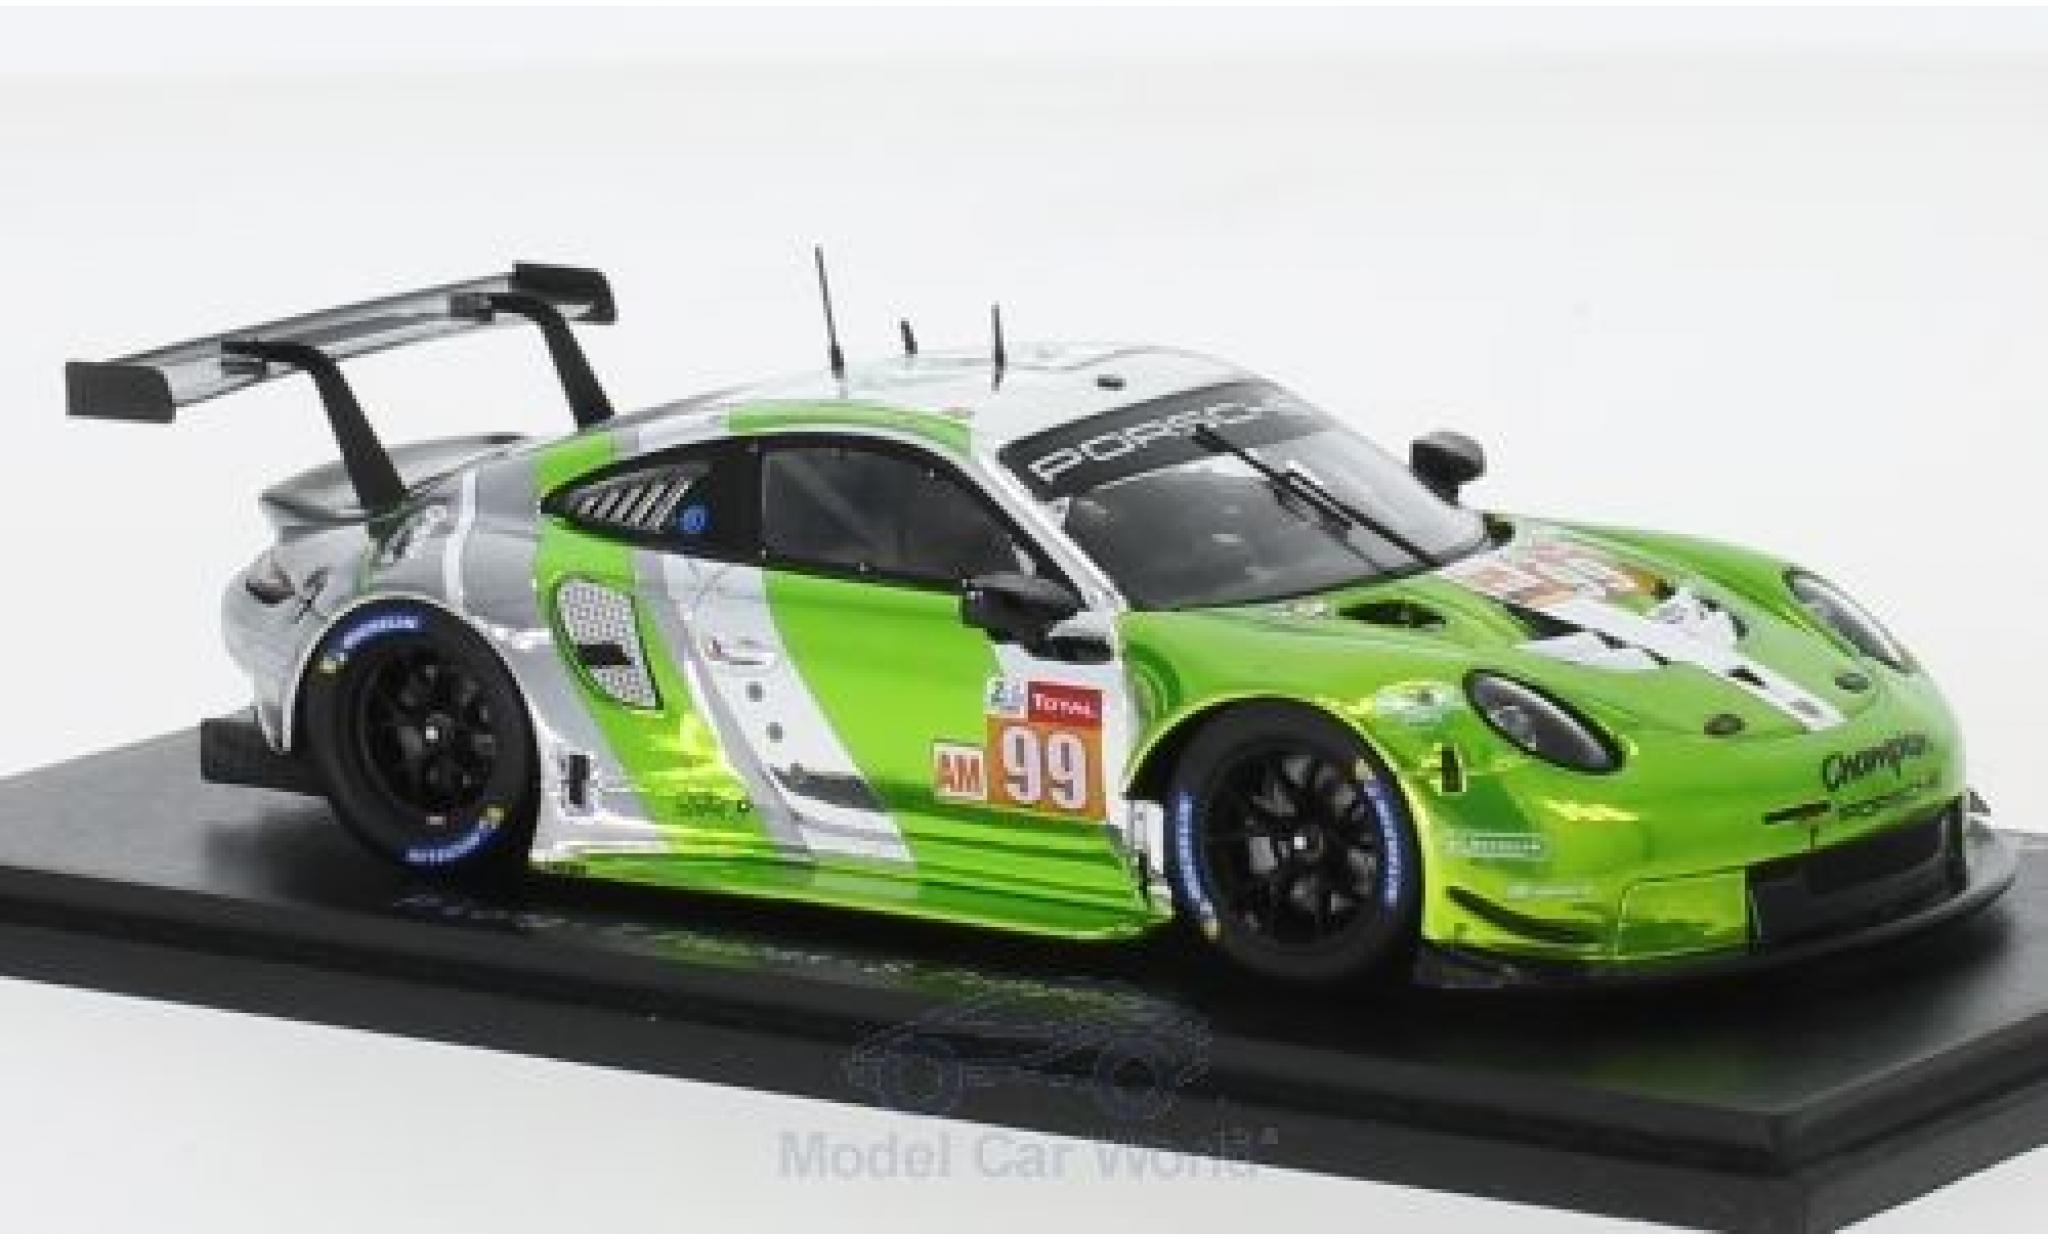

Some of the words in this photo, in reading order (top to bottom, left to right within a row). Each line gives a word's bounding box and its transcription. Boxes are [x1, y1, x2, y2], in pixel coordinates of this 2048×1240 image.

[1031, 692, 1098, 719] TOTAL
[938, 750, 983, 794] AM
[1002, 724, 1087, 810] 99
